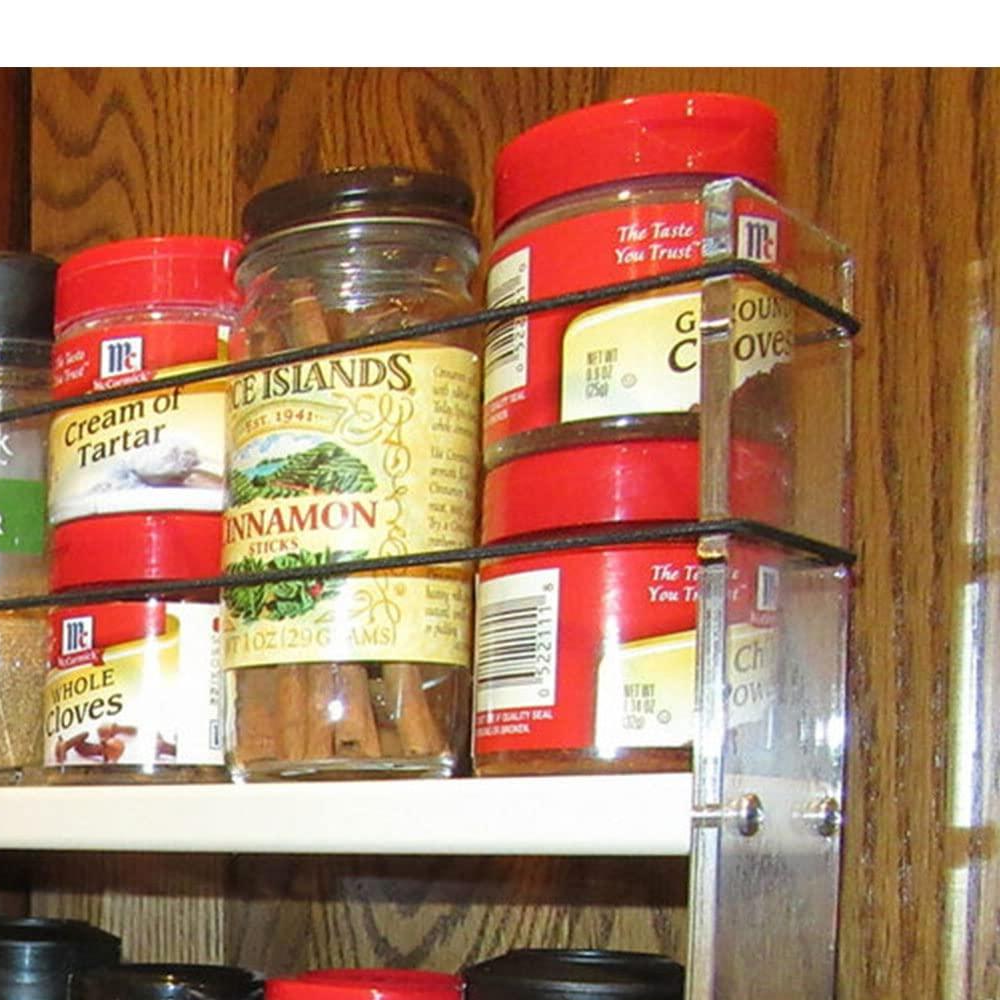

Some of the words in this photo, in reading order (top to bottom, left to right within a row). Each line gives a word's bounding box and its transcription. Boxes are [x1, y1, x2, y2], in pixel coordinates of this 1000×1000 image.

[617, 224, 648, 243] The
[653, 221, 695, 240] Taste
[614, 248, 645, 265] You
[649, 242, 694, 261] Trust
[668, 333, 791, 372] Cove
[262, 352, 412, 400] ISLANDS
[64, 399, 145, 447] Cream
[153, 386, 184, 415] of
[77, 423, 167, 470] Tartar
[249, 537, 299, 555] STICKS
[650, 563, 681, 582] The
[648, 585, 679, 602] You
[315, 626, 397, 648] GAMS)
[45, 692, 124, 738] Cloves
